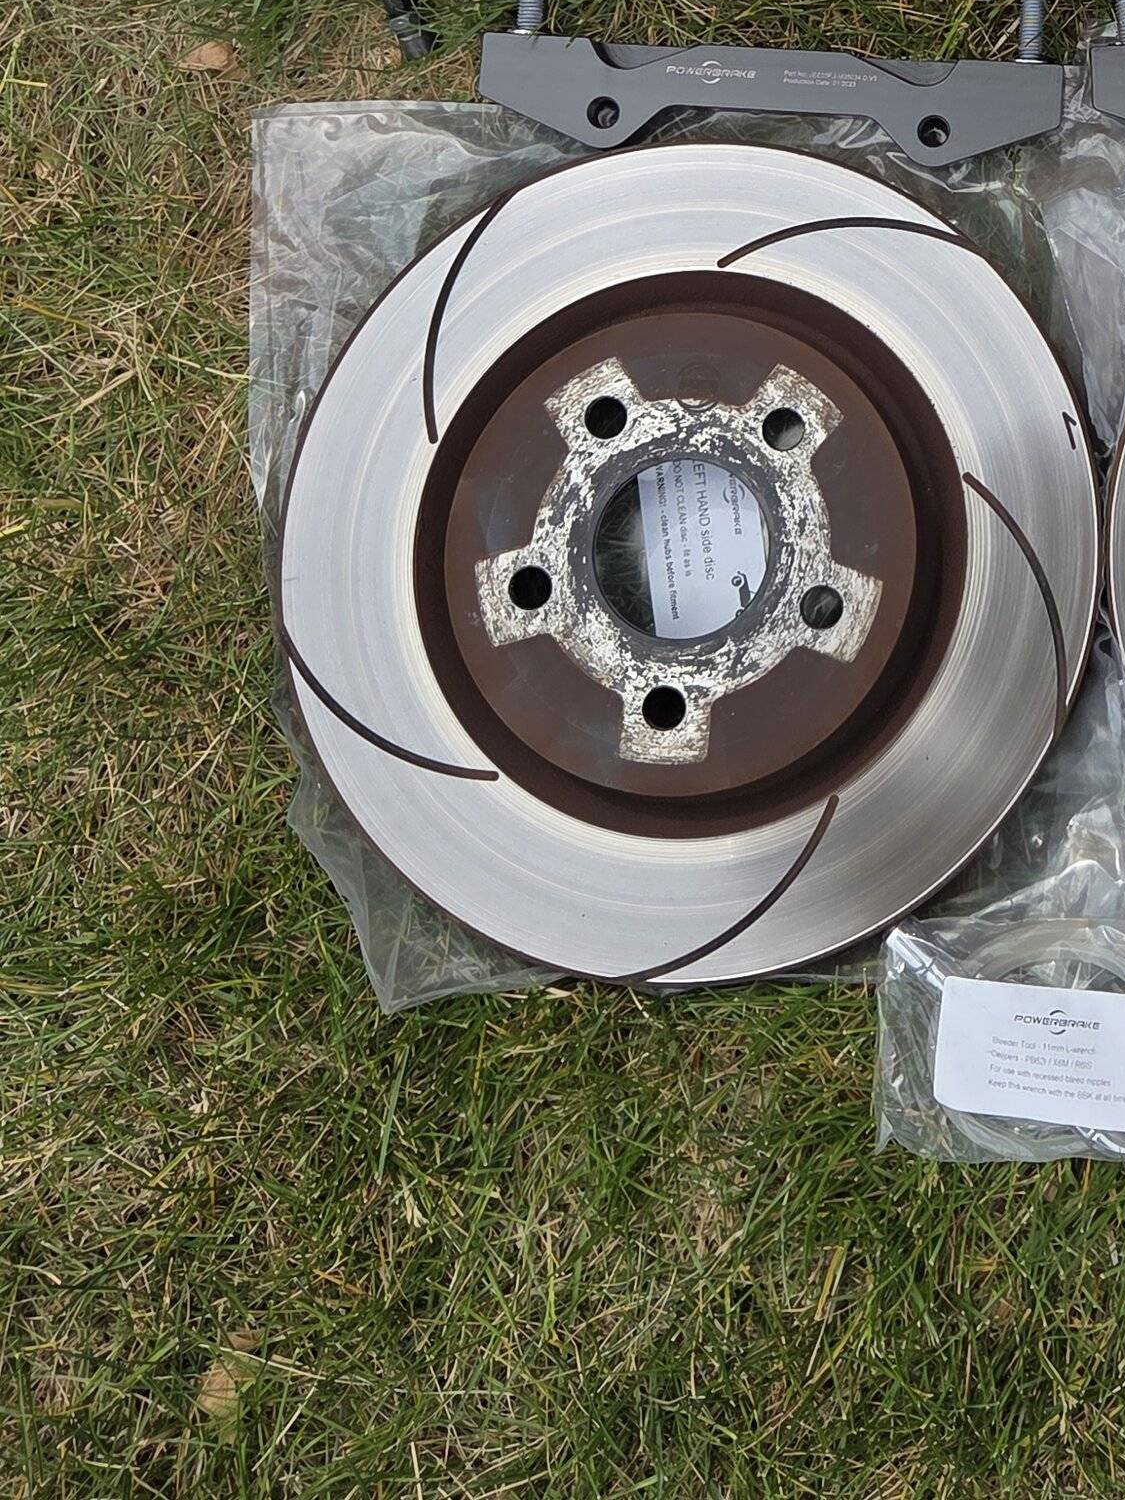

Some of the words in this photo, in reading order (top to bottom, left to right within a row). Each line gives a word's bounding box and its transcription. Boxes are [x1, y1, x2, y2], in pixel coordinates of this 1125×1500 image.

[665, 62, 757, 80] POWERBRAKE
[674, 475, 684, 494] NOT
[676, 495, 687, 525] CLEAN
[696, 490, 711, 526] HAND
[660, 514, 669, 539] clean
[663, 539, 672, 561] hubs
[700, 528, 713, 554] side
[665, 562, 675, 589] before
[704, 557, 715, 581] disc
[669, 590, 680, 621] fitment
[1014, 1014, 1101, 1030] POWERBRAKE
